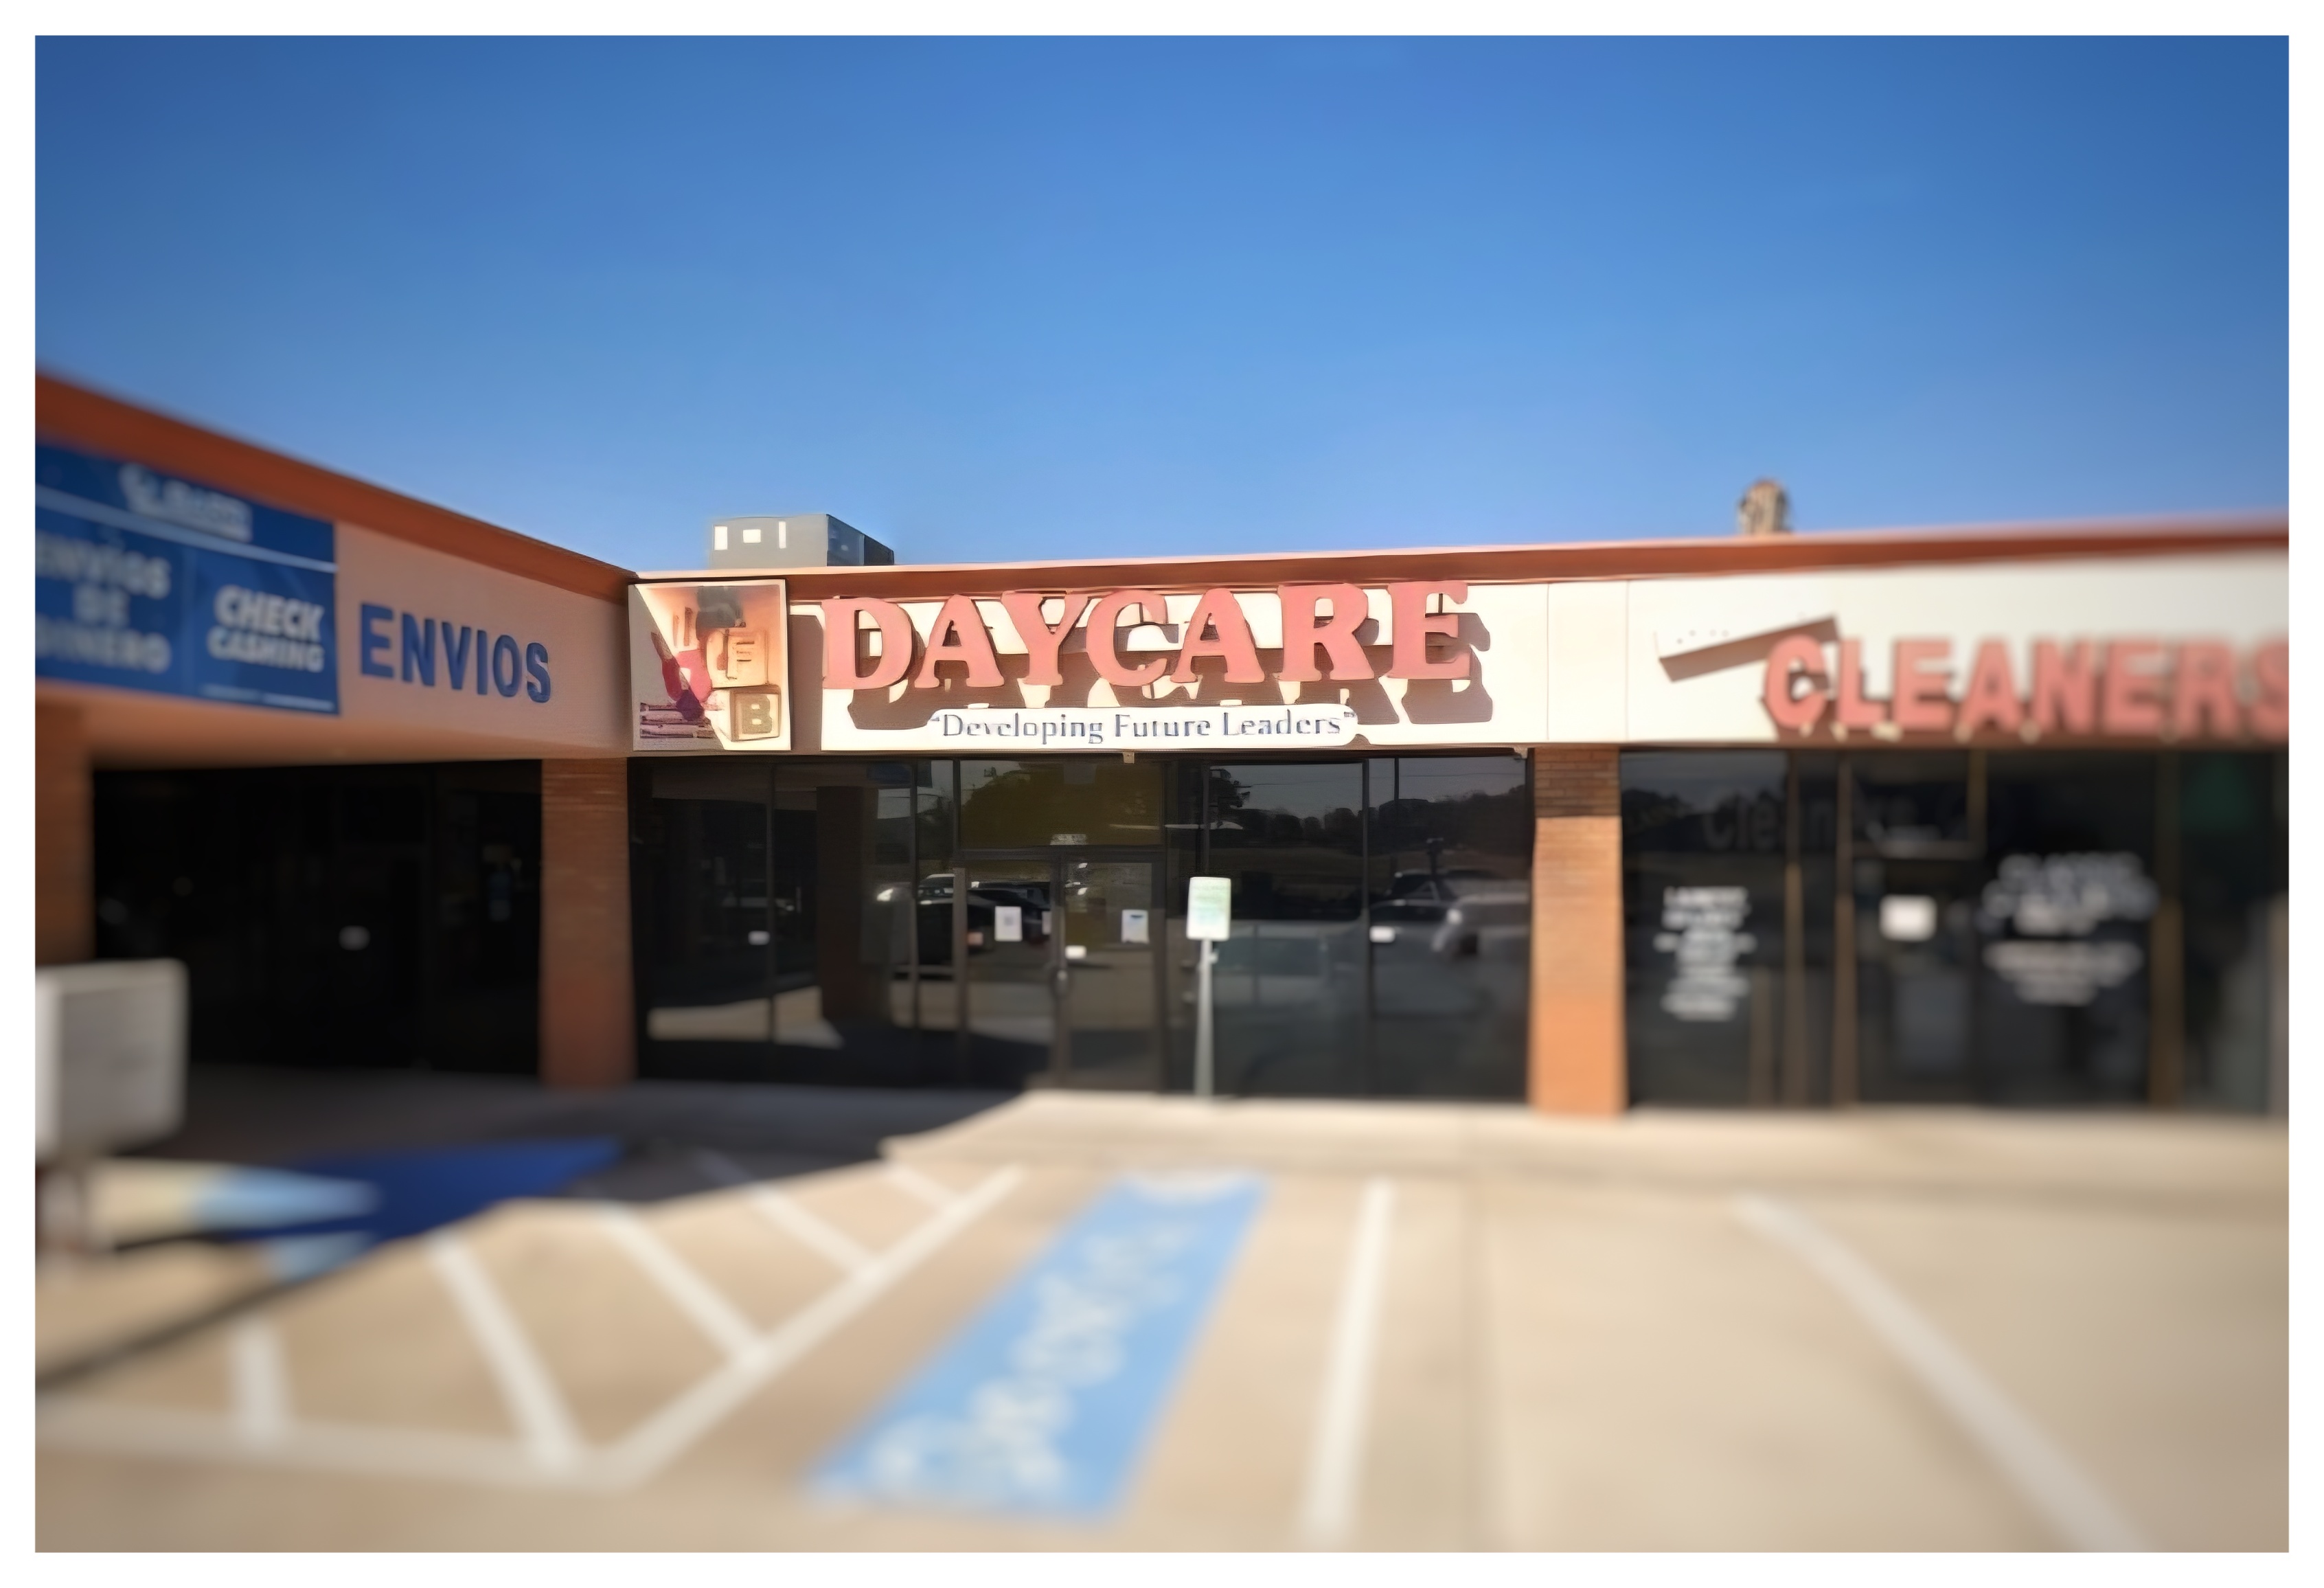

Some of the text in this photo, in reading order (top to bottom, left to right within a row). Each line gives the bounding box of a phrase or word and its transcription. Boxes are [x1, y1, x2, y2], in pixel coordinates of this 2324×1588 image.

[214, 585, 324, 643] CHECK
[821, 581, 1472, 689] DAYCARE
[207, 625, 323, 672] CASHING
[361, 602, 551, 703] ENVIOS
[742, 694, 773, 735] B
[1763, 633, 2289, 740] CLEANERS
[1115, 714, 1211, 737] Future
